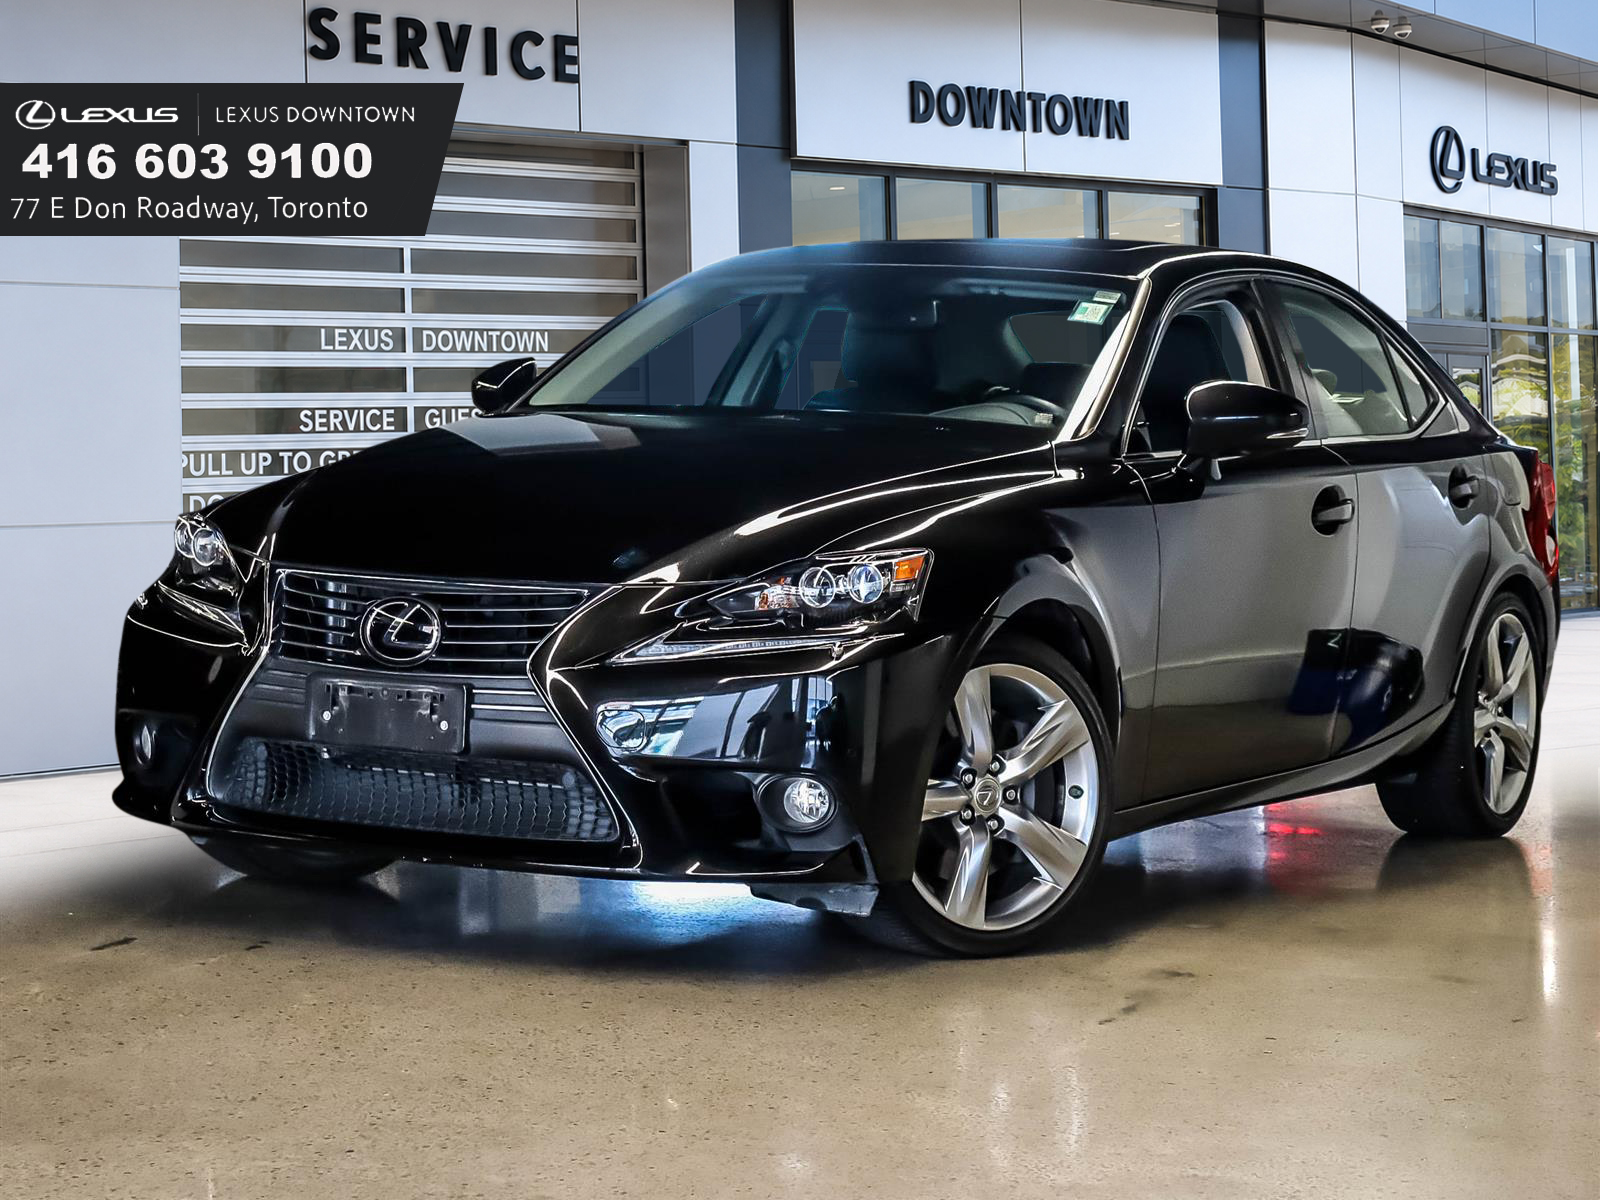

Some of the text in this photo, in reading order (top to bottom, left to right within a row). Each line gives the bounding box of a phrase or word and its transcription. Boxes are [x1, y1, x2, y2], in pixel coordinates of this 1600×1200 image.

[308, 7, 579, 83] SERVICE
[908, 80, 1130, 141] DOWNTOWN
[1471, 147, 1558, 195] LEXUS
[320, 328, 549, 353] LEXUS DOWNTOWN
[299, 409, 395, 432] SERVICE
[240, 452, 272, 475] UP
[279, 451, 312, 474] TO
